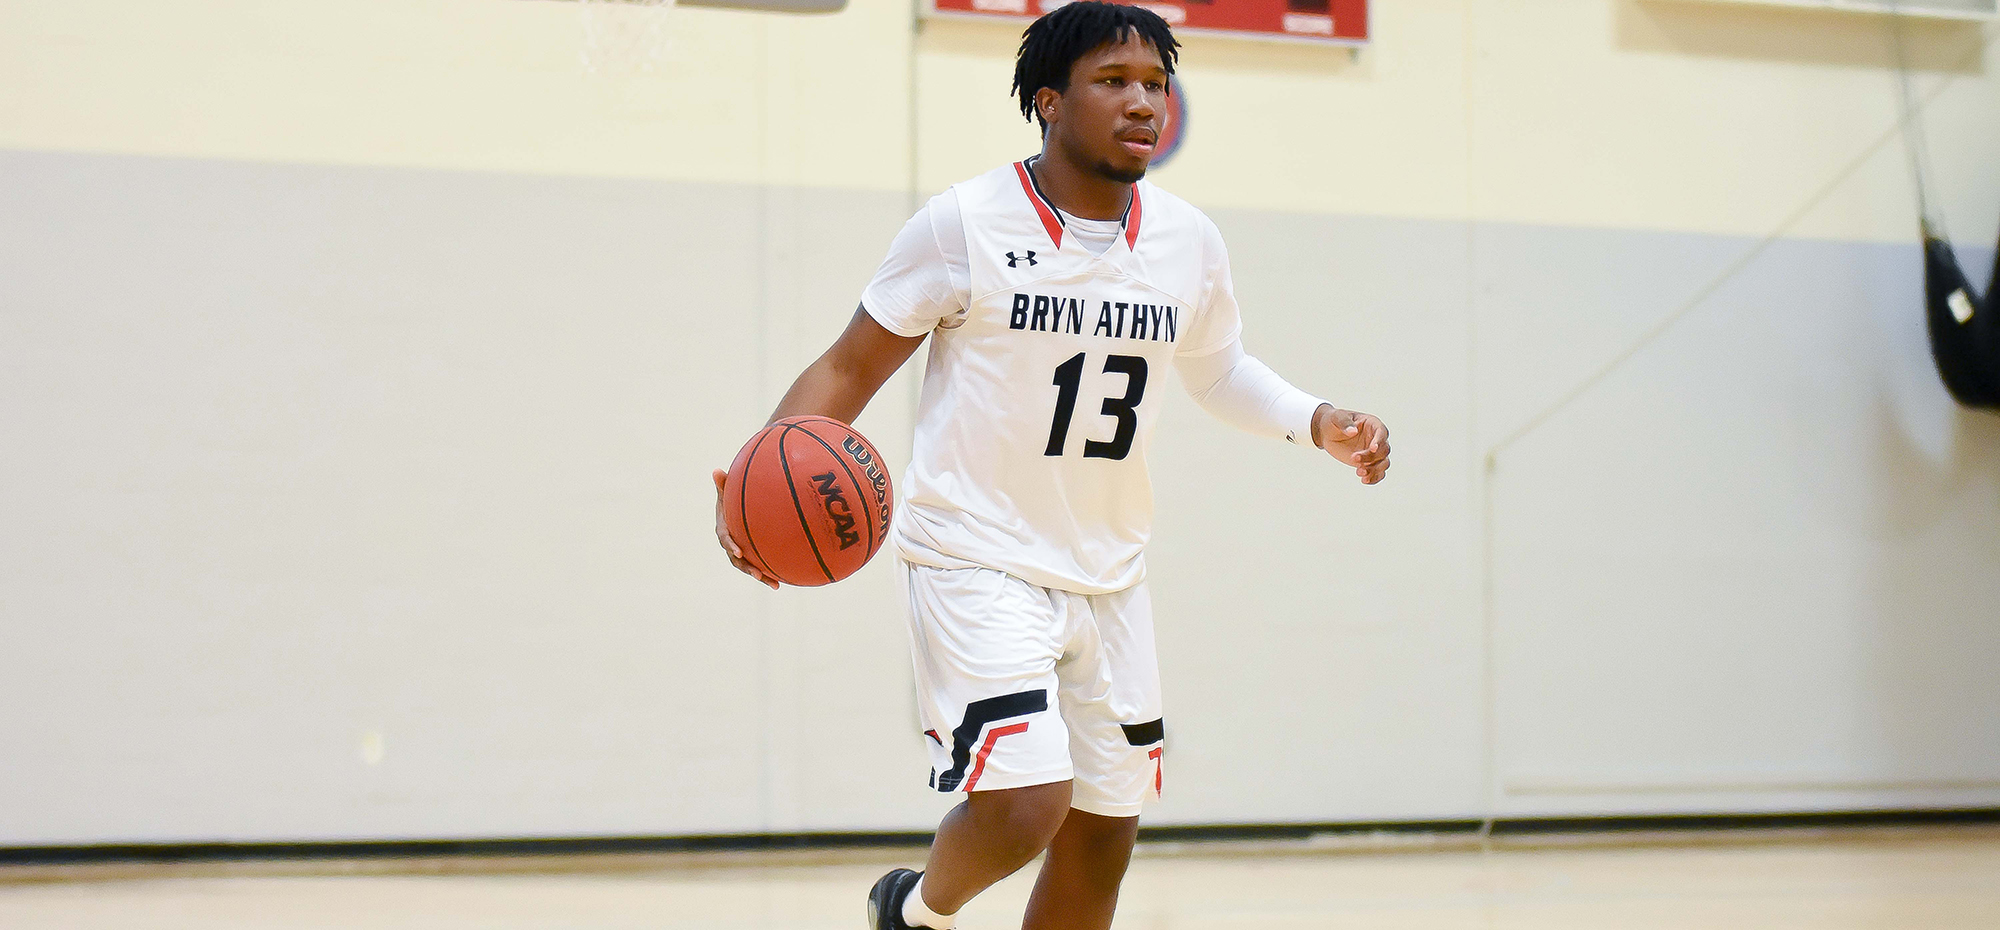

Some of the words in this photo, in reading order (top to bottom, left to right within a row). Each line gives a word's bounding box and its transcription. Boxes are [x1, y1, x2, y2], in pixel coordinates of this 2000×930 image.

[1009, 293, 1085, 335] BRYN
[1093, 301, 1178, 343] ATHYN
[1044, 352, 1149, 461] 13
[811, 471, 860, 551] NCAA
